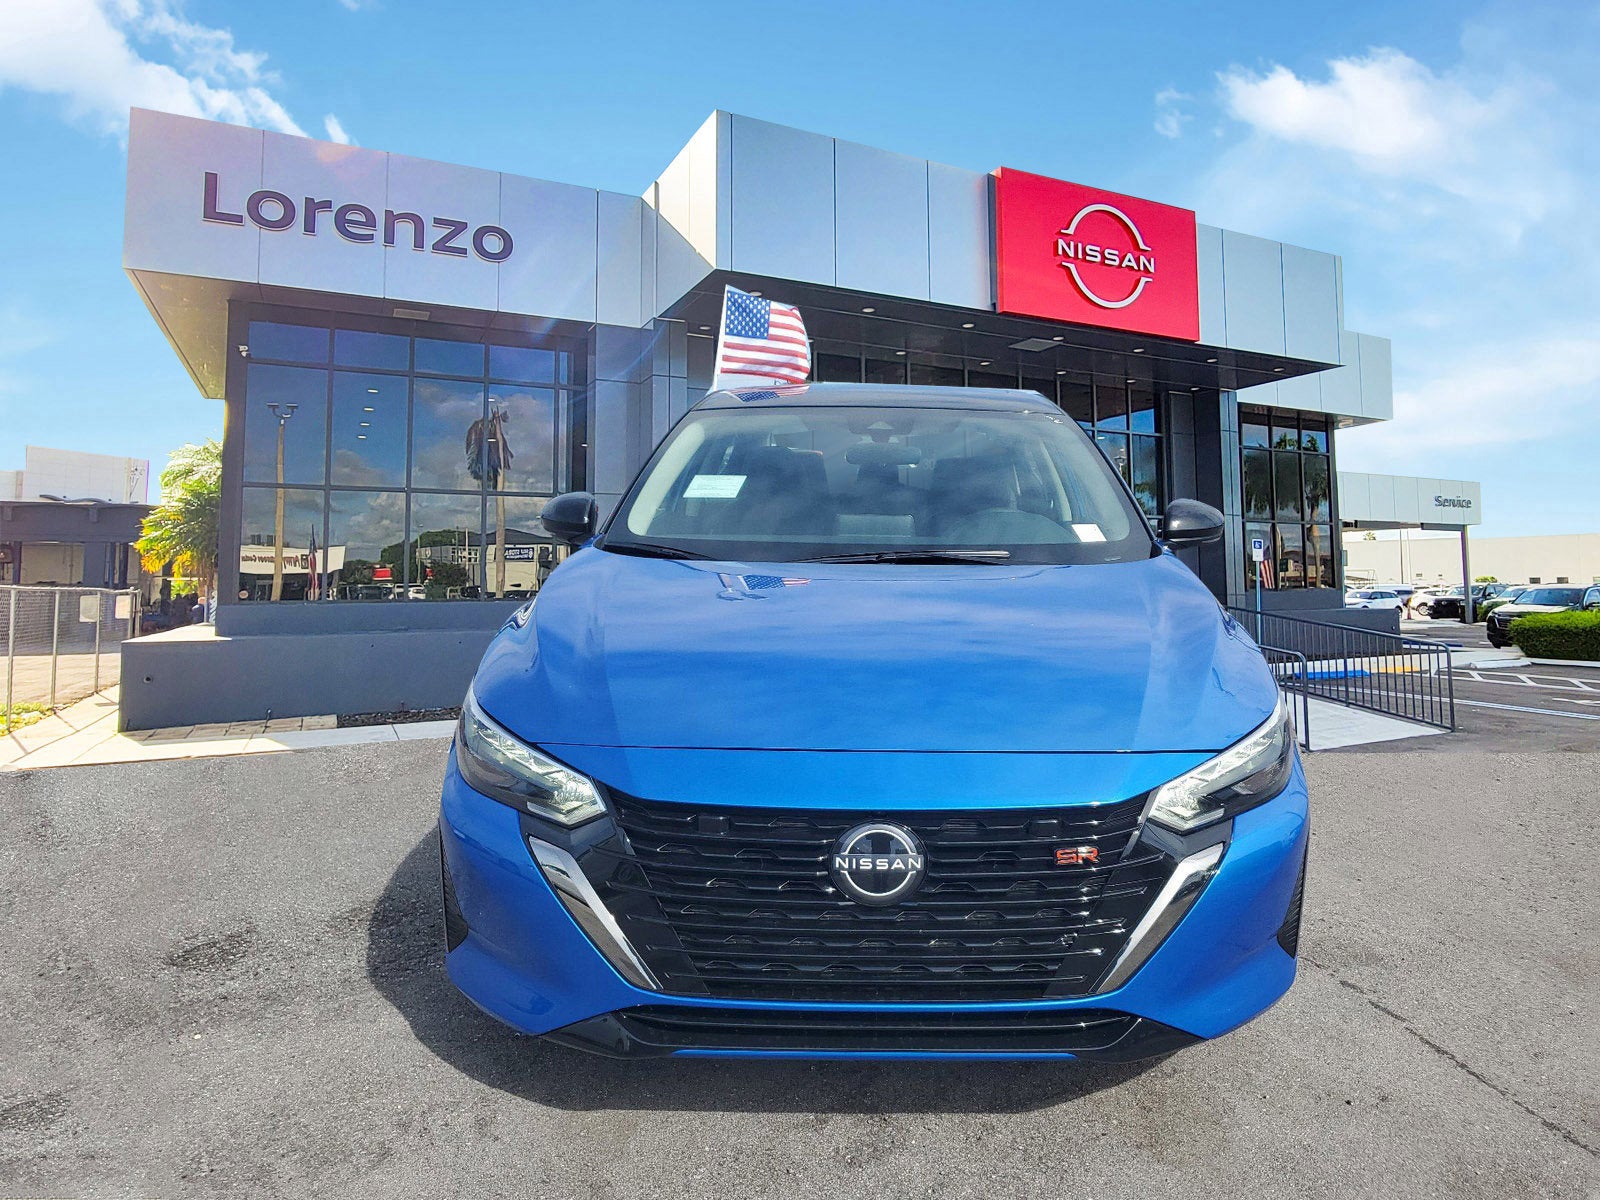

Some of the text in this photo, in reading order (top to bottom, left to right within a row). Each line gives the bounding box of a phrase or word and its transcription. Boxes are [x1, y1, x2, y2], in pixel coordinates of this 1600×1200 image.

[202, 171, 514, 262] Lorenzo
[1057, 238, 1155, 273] NISSAN
[1434, 495, 1472, 508] Service
[835, 857, 922, 870] NISSAN
[1056, 846, 1099, 865] SR
